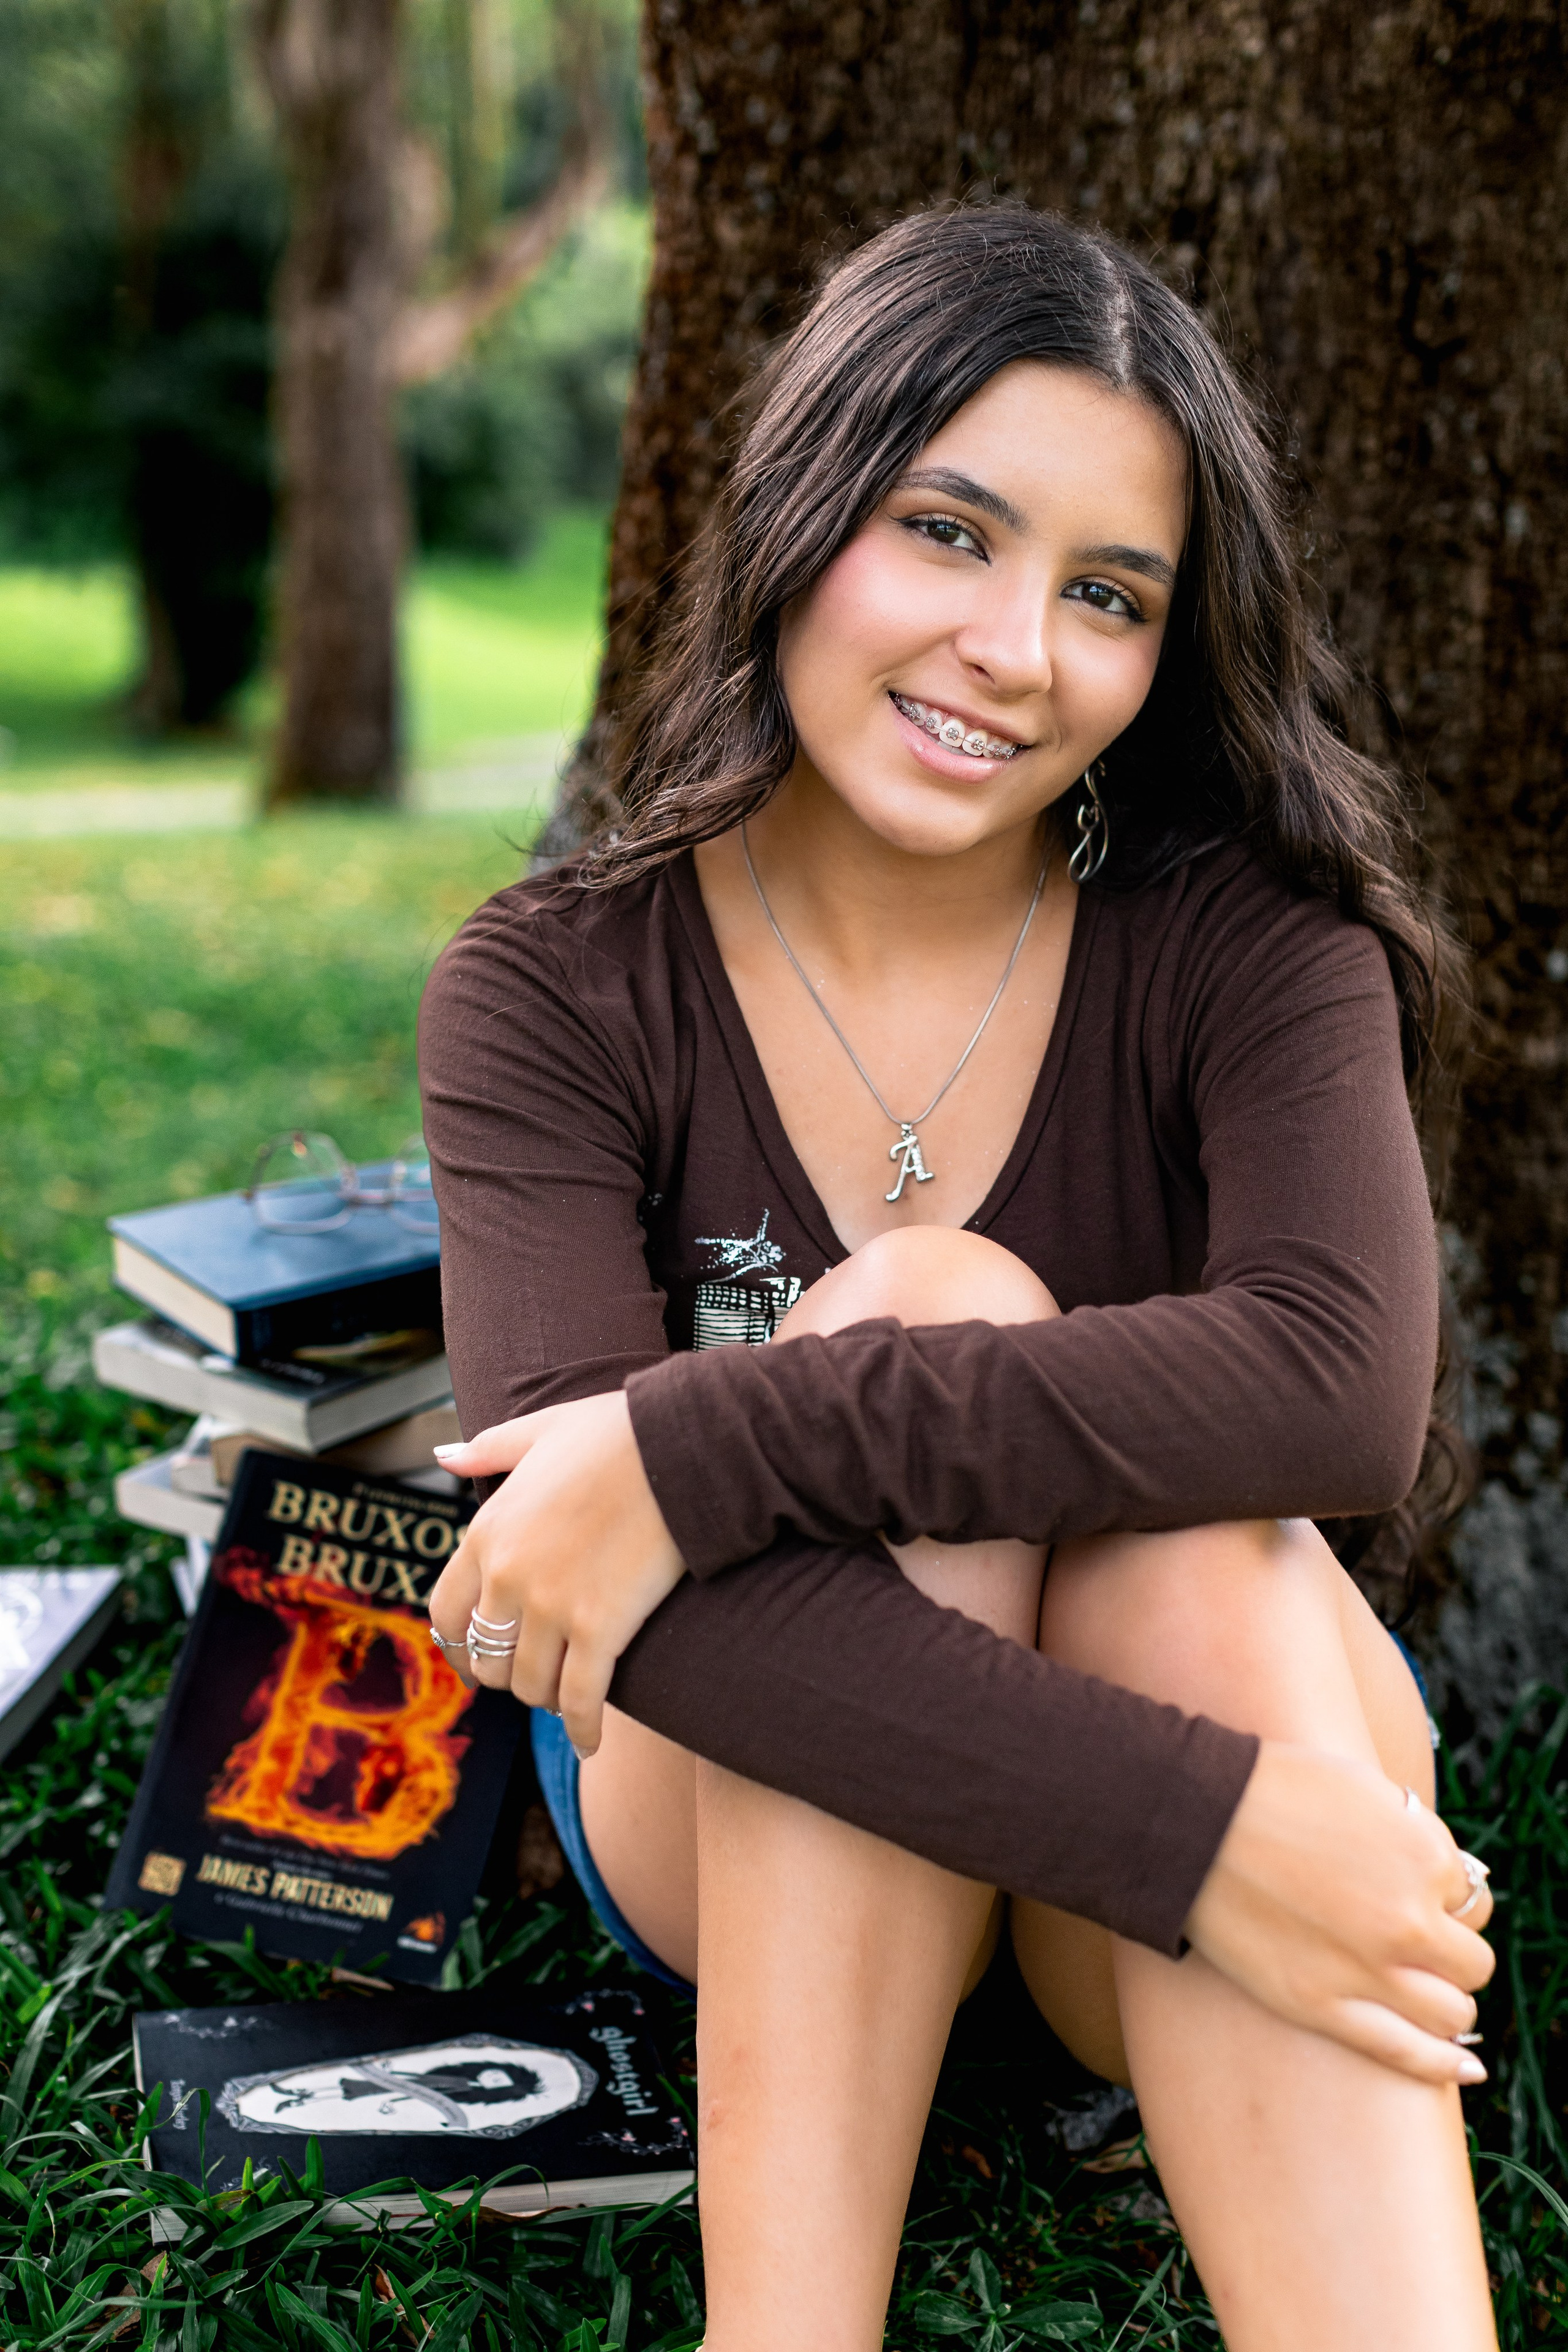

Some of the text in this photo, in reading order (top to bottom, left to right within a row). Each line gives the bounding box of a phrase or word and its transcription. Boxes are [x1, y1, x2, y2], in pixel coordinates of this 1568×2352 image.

[273, 1532, 436, 1607] BRUX
[195, 1853, 271, 1896] JAMES
[270, 1870, 395, 1922] PATTERSON
[588, 2026, 660, 2116] ghostgirl
